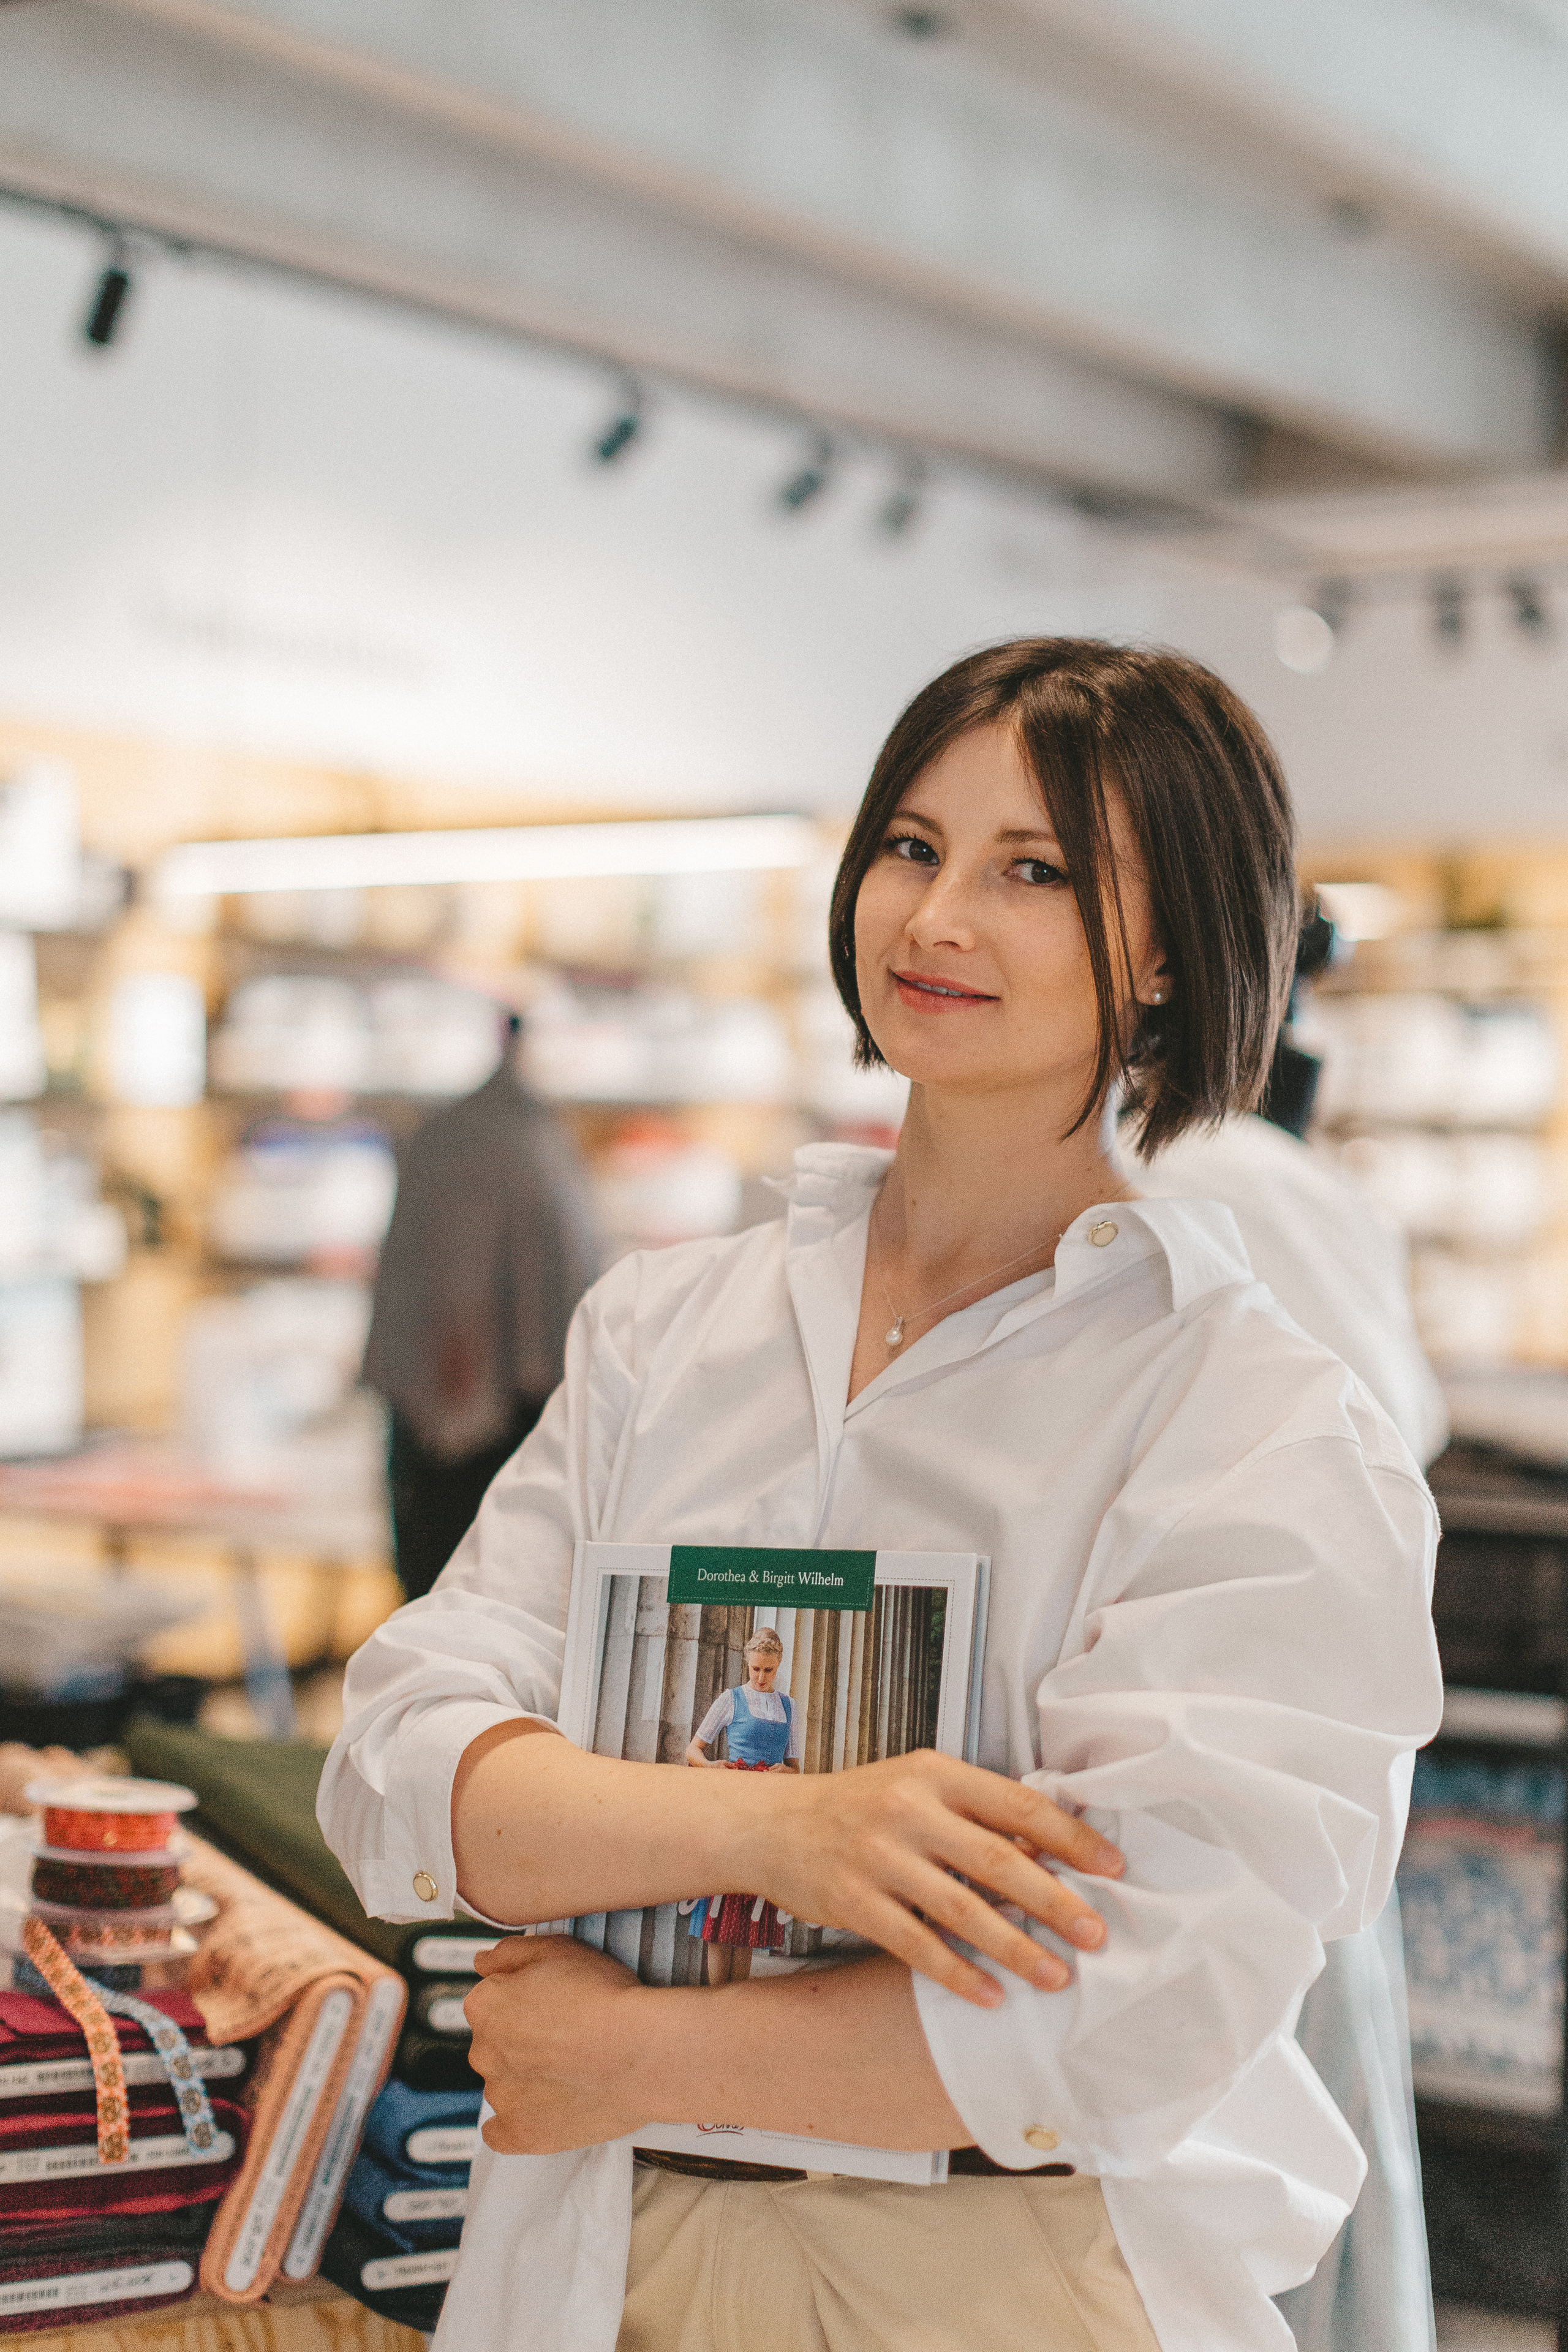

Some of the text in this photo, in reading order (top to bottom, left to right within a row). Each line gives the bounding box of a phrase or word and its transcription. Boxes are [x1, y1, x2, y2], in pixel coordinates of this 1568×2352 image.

[697, 1568, 844, 1588] Dorothea & Birgitt Wilhelm
